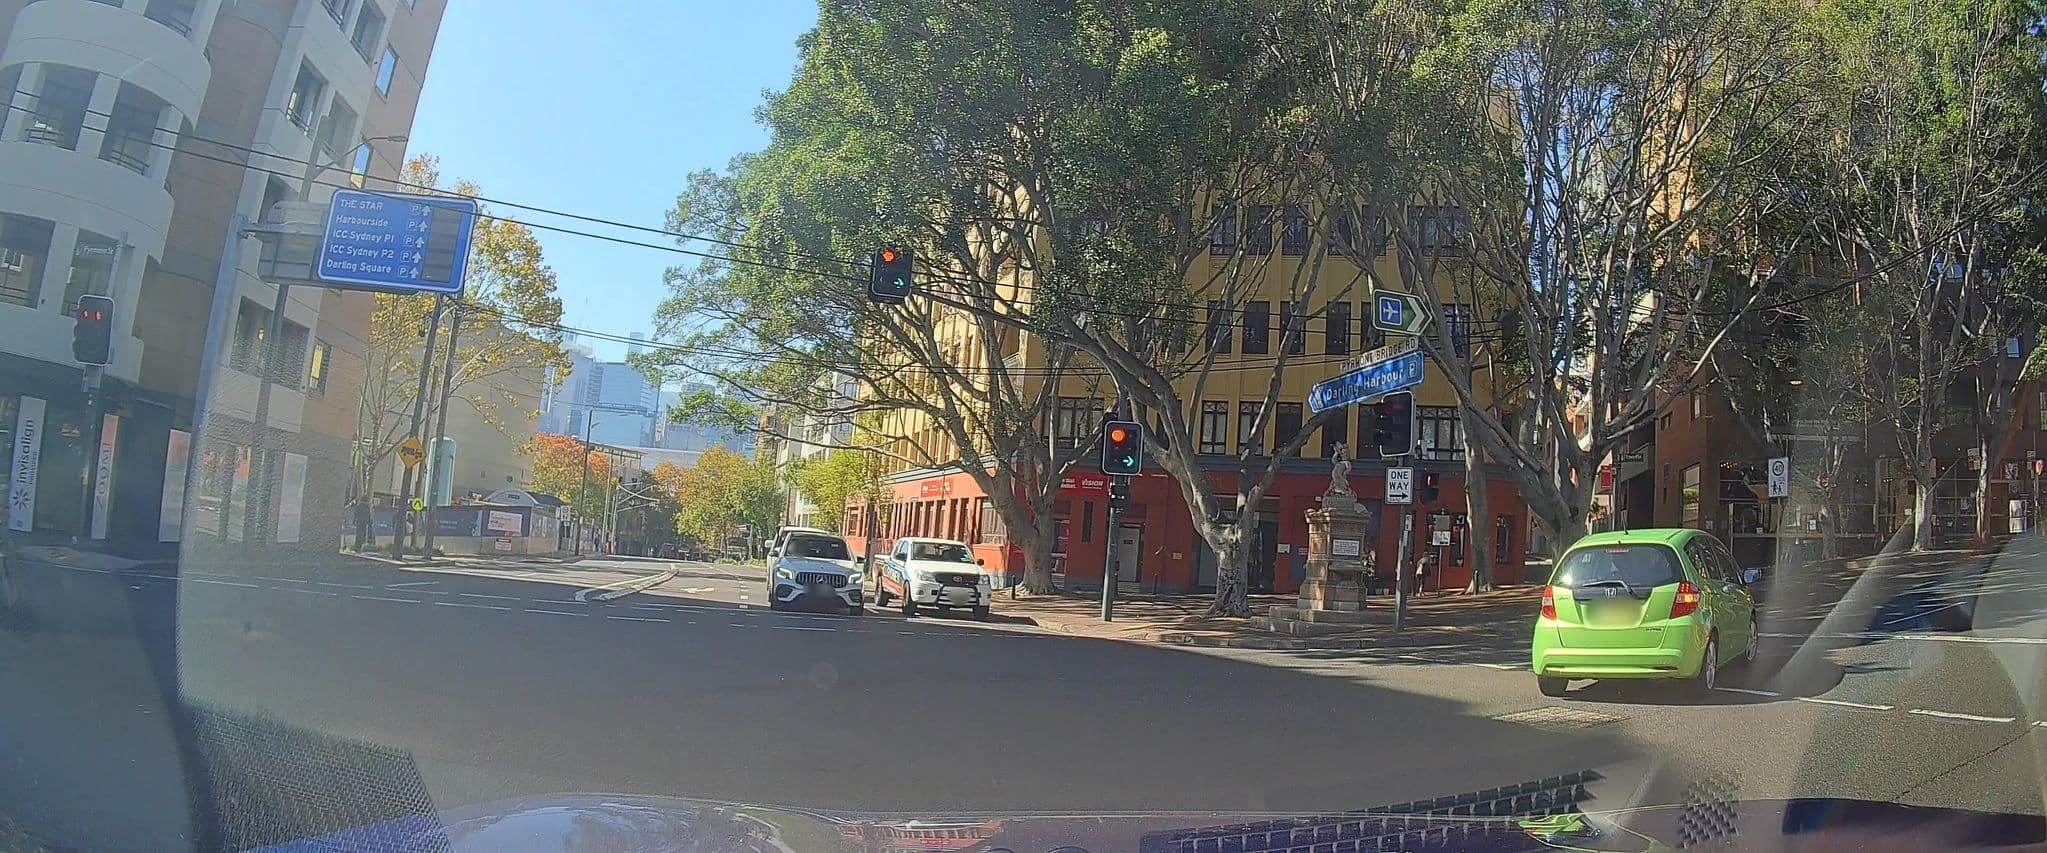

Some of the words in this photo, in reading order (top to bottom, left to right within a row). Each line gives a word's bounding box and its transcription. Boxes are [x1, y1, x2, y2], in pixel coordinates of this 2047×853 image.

[340, 199, 357, 209] THE
[359, 200, 383, 210] STAR
[335, 214, 389, 228] Harbourside
[332, 229, 348, 239] ICC
[350, 230, 382, 244] Sydney
[384, 234, 395, 243] P1
[329, 244, 345, 254] ICC
[346, 246, 379, 259] Sydney
[381, 249, 394, 258] P2
[326, 258, 357, 272] Darling
[359, 261, 392, 274] Square
[1376, 342, 1402, 361] BRIDGE
[1405, 338, 1416, 351] RD
[1326, 383, 1359, 401] Darling
[1363, 367, 1404, 388] Harbour
[16, 419, 34, 484] invisalign
[1081, 479, 1104, 487] VISION
[1390, 471, 1409, 480] ONE
[1389, 481, 1409, 490] WAY
